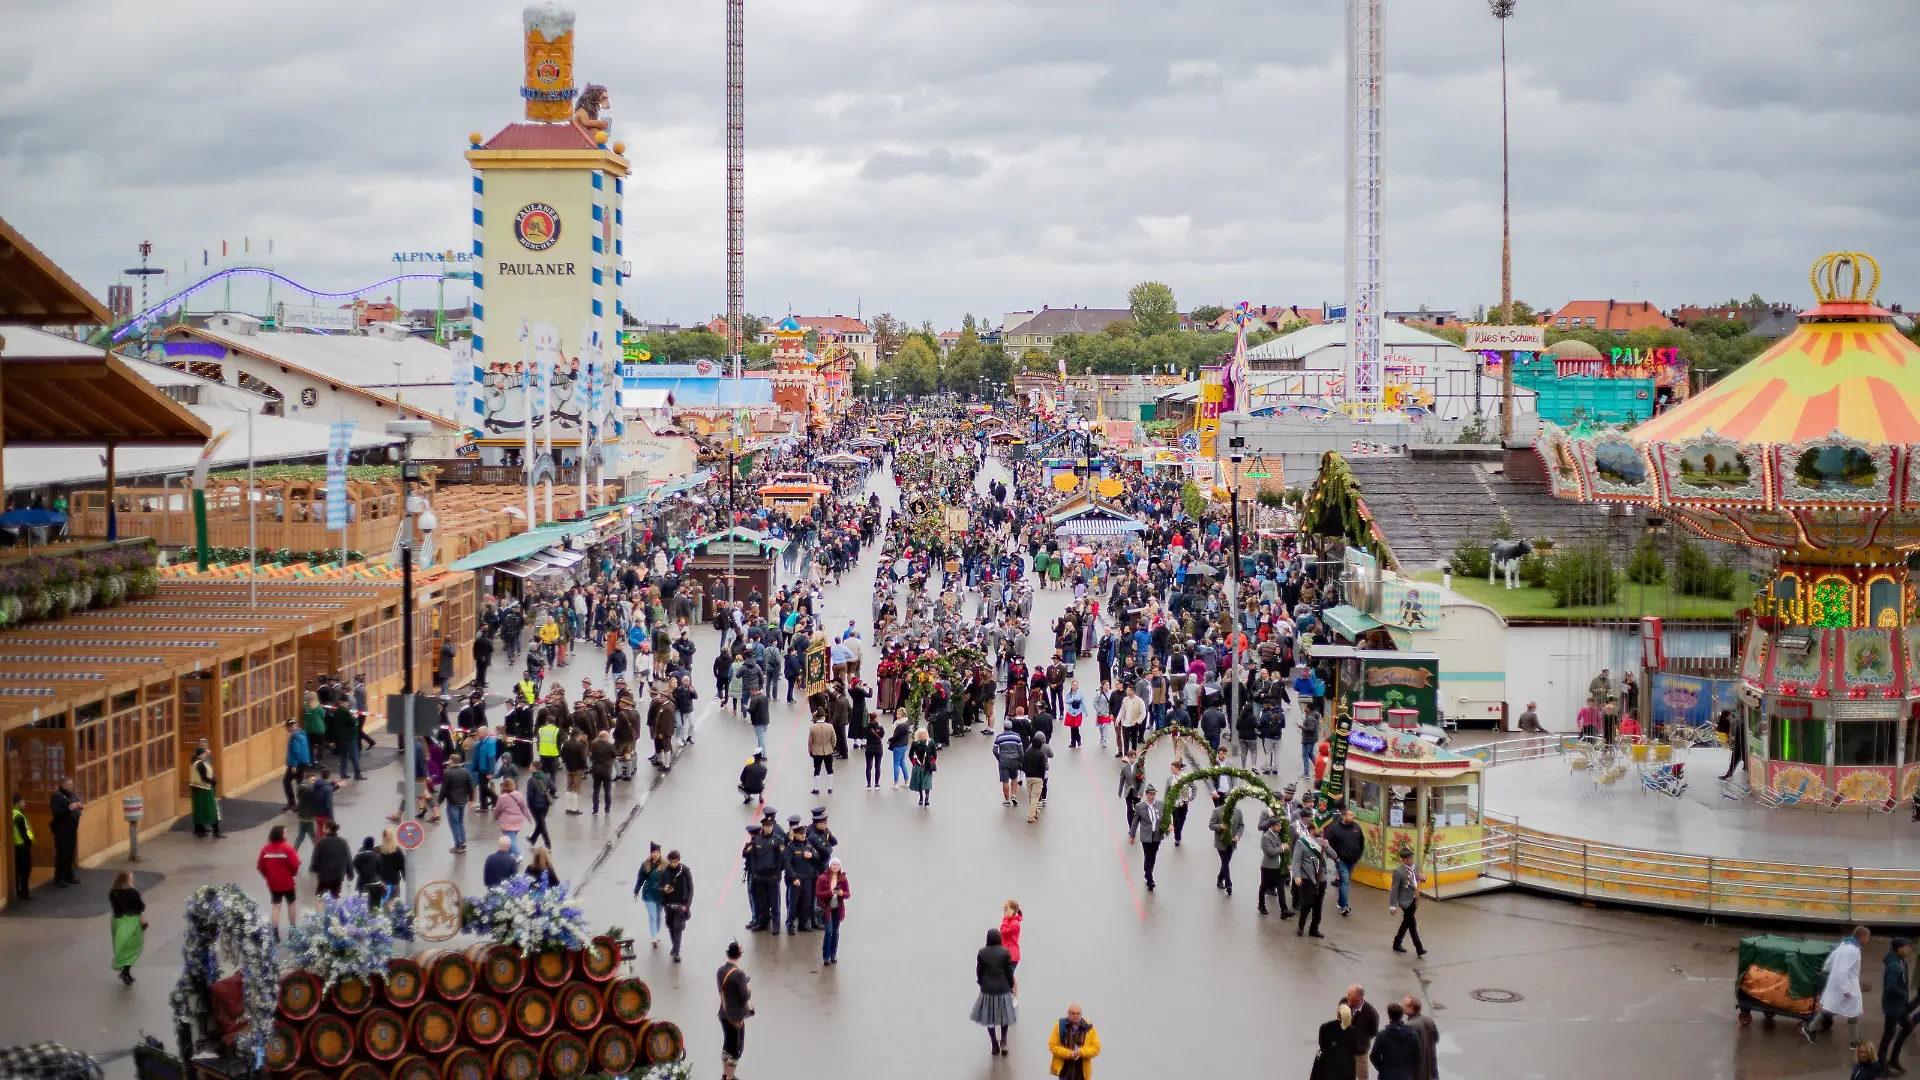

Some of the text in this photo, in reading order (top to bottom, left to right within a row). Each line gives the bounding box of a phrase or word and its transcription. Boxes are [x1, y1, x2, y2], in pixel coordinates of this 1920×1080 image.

[516, 204, 559, 222] PAULANER
[519, 238, 556, 250] MÜNCHEN
[392, 252, 444, 262] ALPINA
[499, 262, 575, 275] PAULANER
[1610, 347, 1679, 366] PALAST
